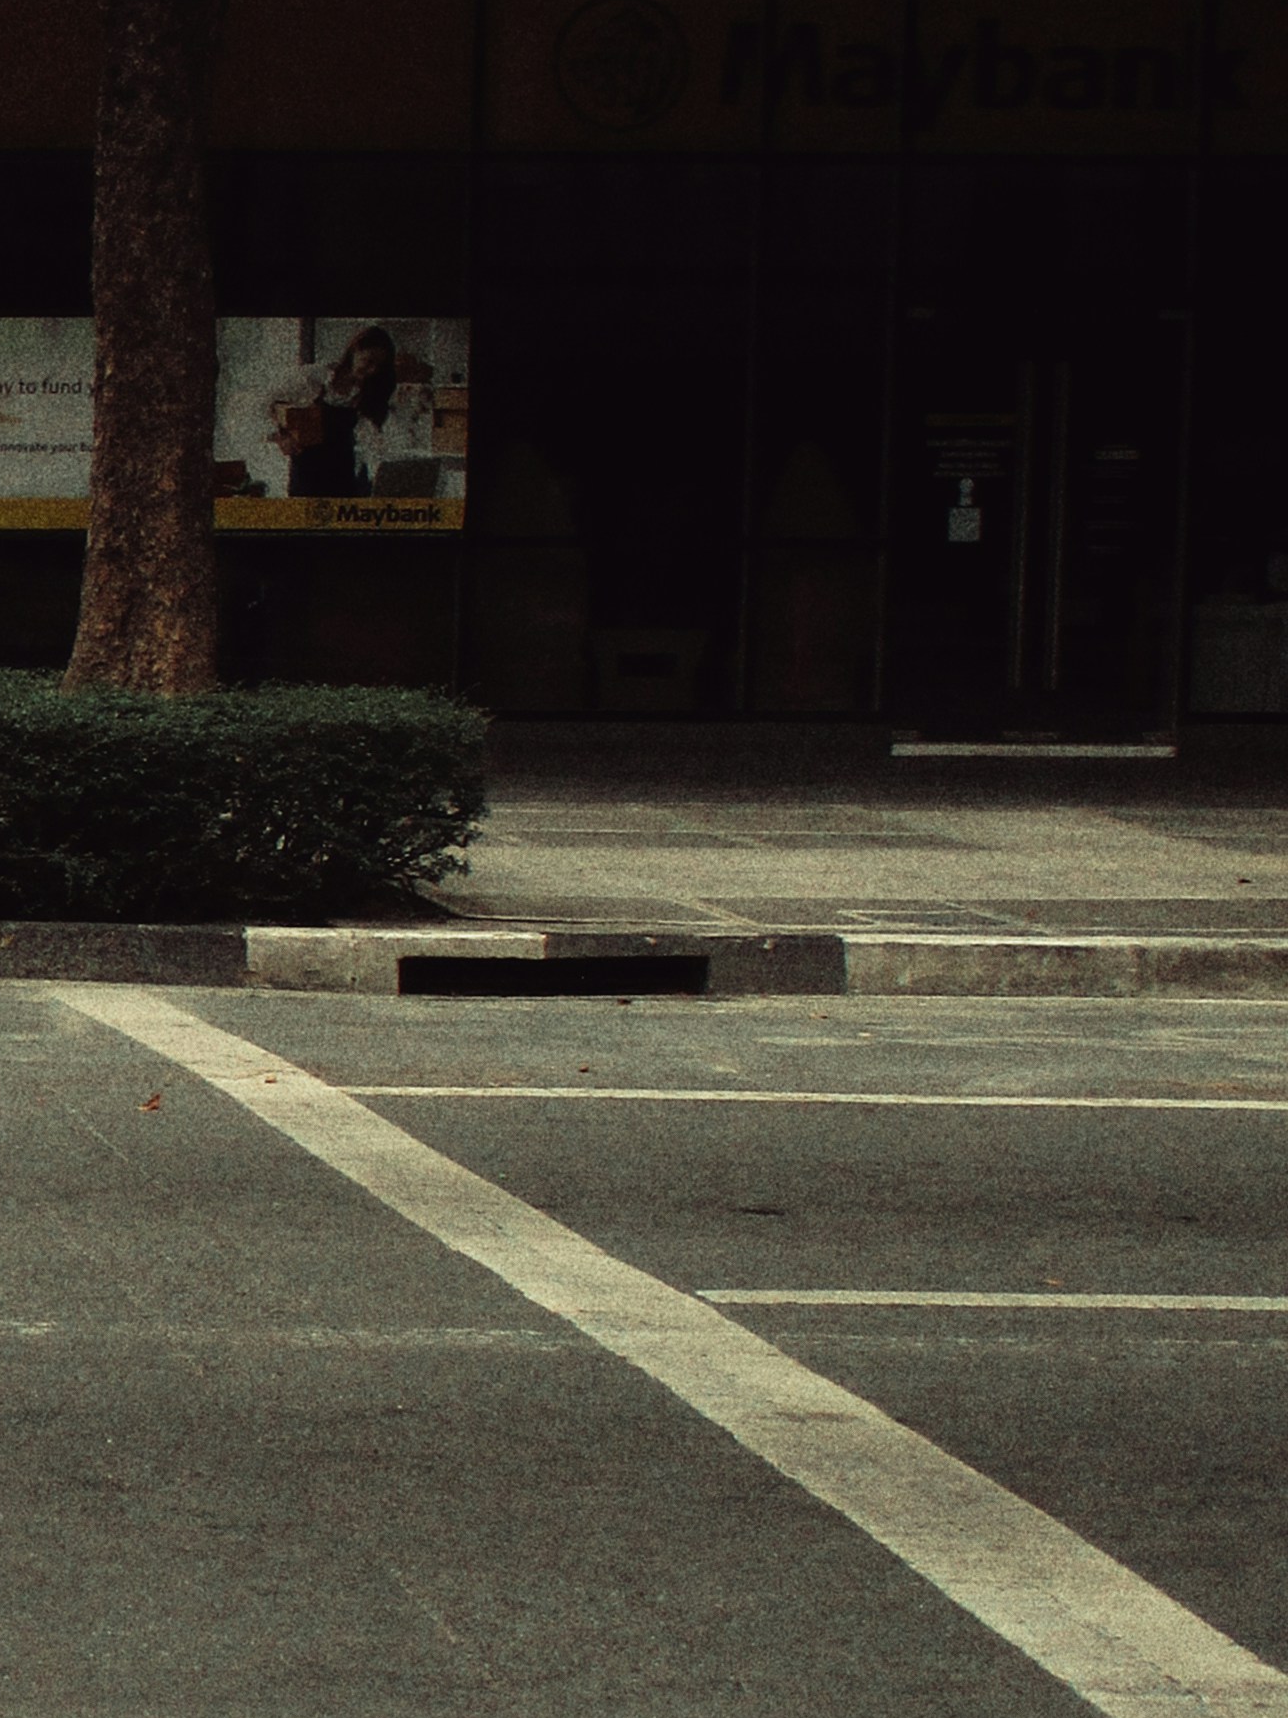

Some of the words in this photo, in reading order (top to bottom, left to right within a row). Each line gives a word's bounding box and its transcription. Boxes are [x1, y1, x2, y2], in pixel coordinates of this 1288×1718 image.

[721, 19, 1246, 131] Maybank
[19, 380, 37, 393] to
[42, 378, 82, 393] fund
[50, 444, 78, 455] your
[336, 504, 442, 525] Maybank
